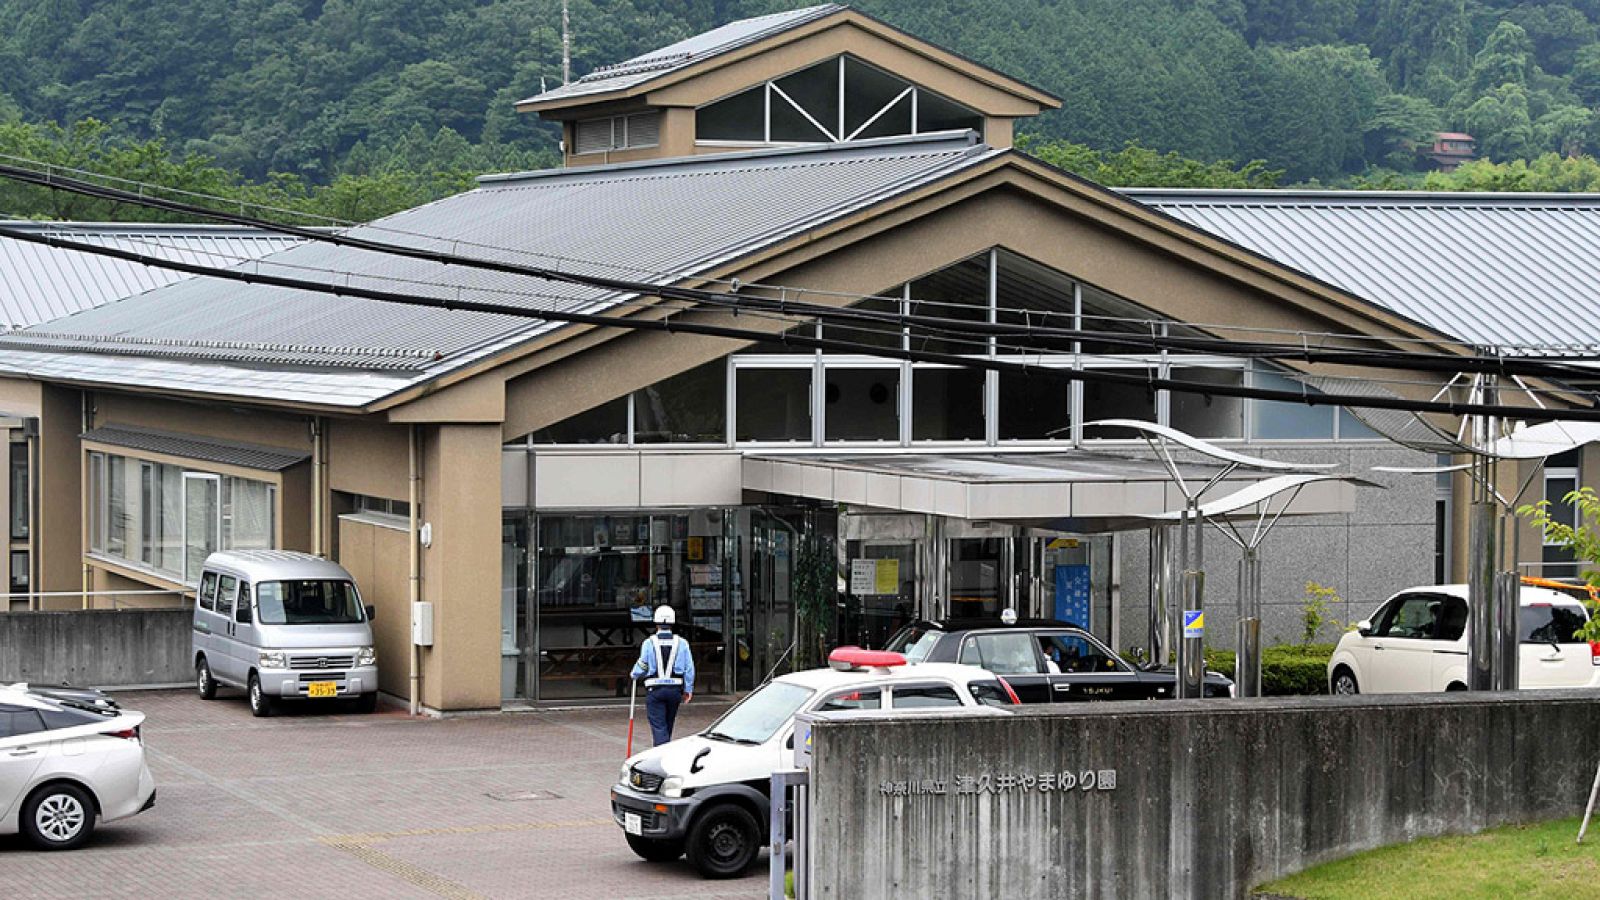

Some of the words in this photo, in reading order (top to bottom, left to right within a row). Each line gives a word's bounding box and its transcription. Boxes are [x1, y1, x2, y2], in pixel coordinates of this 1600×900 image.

[955, 769, 1117, 795] 津久井やまゆり園
